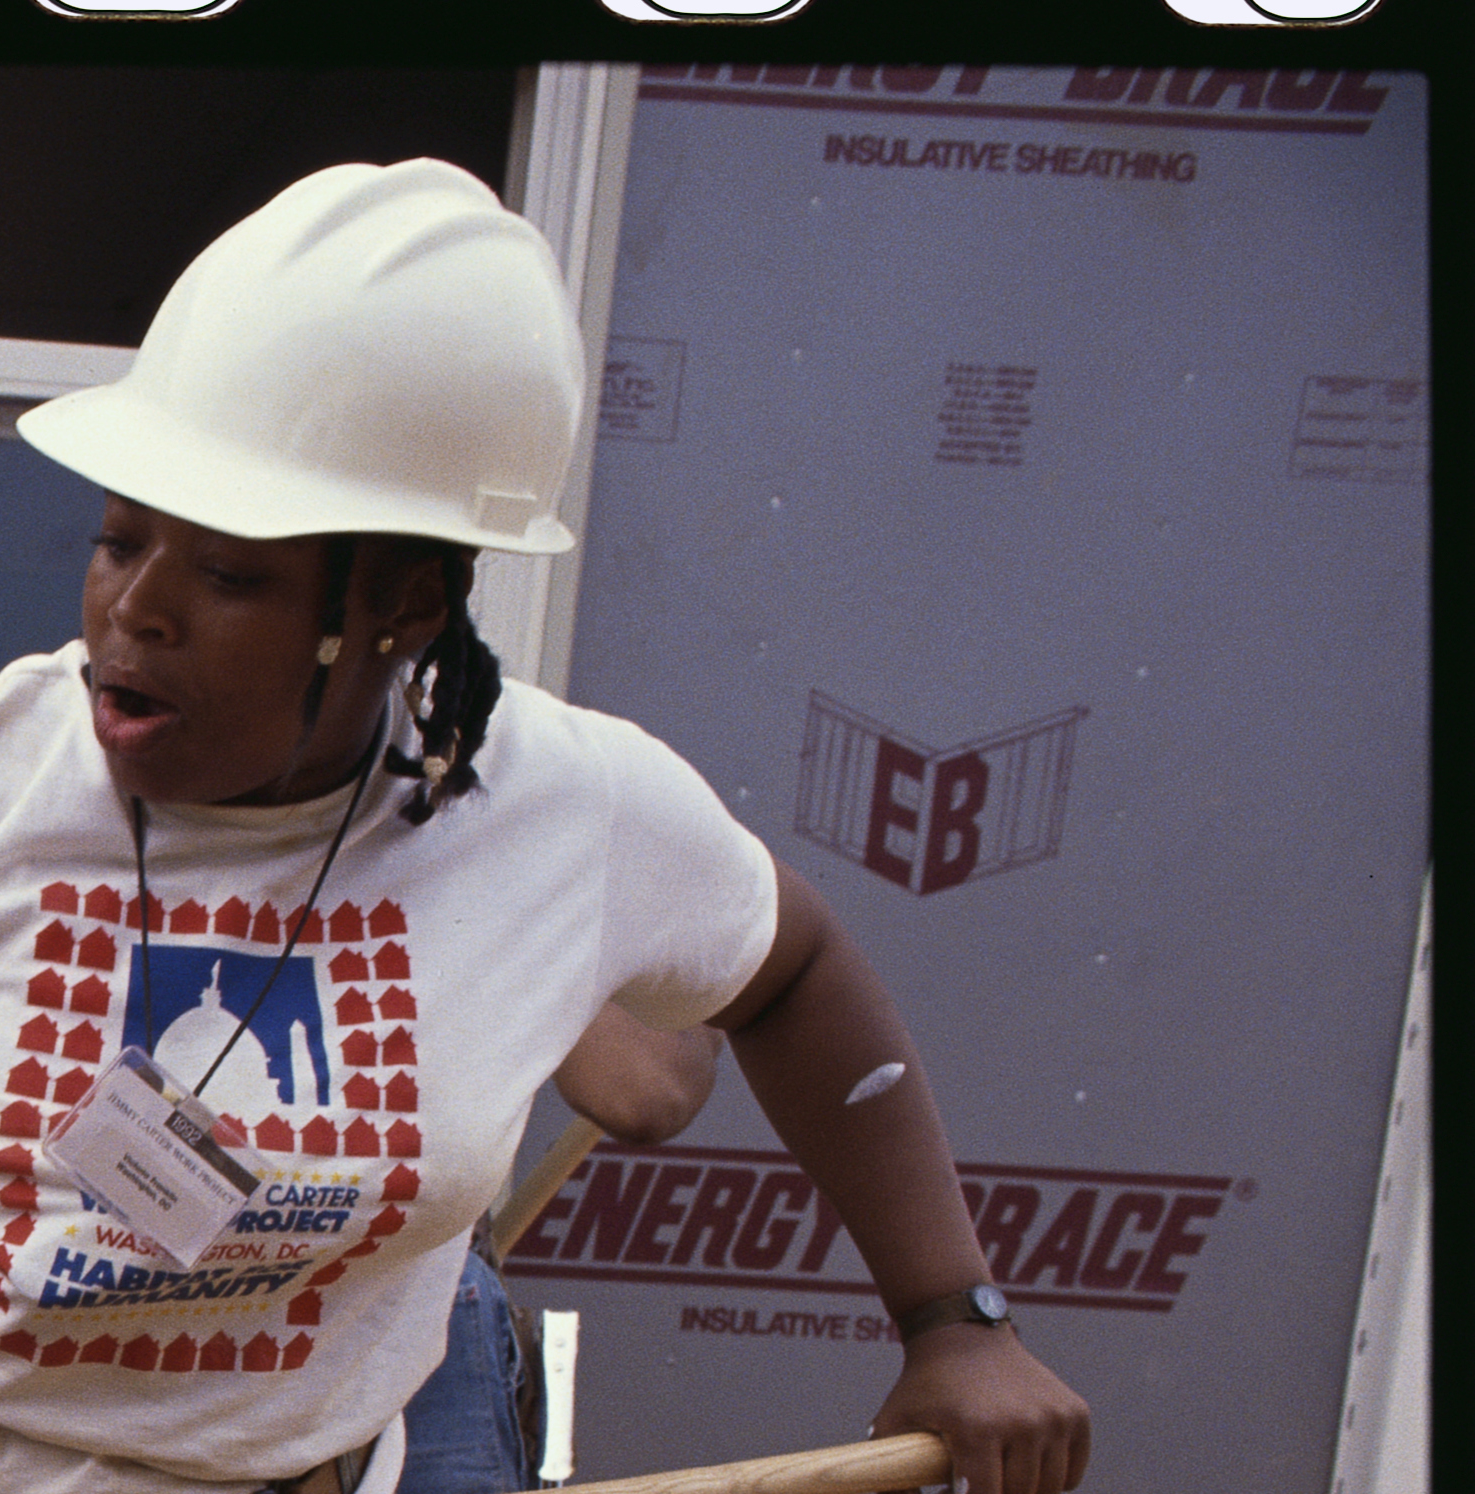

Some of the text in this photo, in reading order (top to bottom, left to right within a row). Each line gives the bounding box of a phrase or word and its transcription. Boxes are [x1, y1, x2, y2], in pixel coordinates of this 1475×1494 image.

[825, 136, 1196, 181] INSULATIVE SHEATHING
[860, 737, 989, 896] EB
[106, 1091, 236, 1207] JIMMY CARTER WORK PROJECT
[169, 1114, 204, 1148] 1992
[265, 1184, 360, 1208] CARTER
[230, 1209, 350, 1234] ROJECT
[49, 1246, 234, 1291] HABITAT
[276, 1243, 310, 1260] DC
[37, 1271, 300, 1309] HUMANITY
[679, 1305, 849, 1341] INSULATIVE
